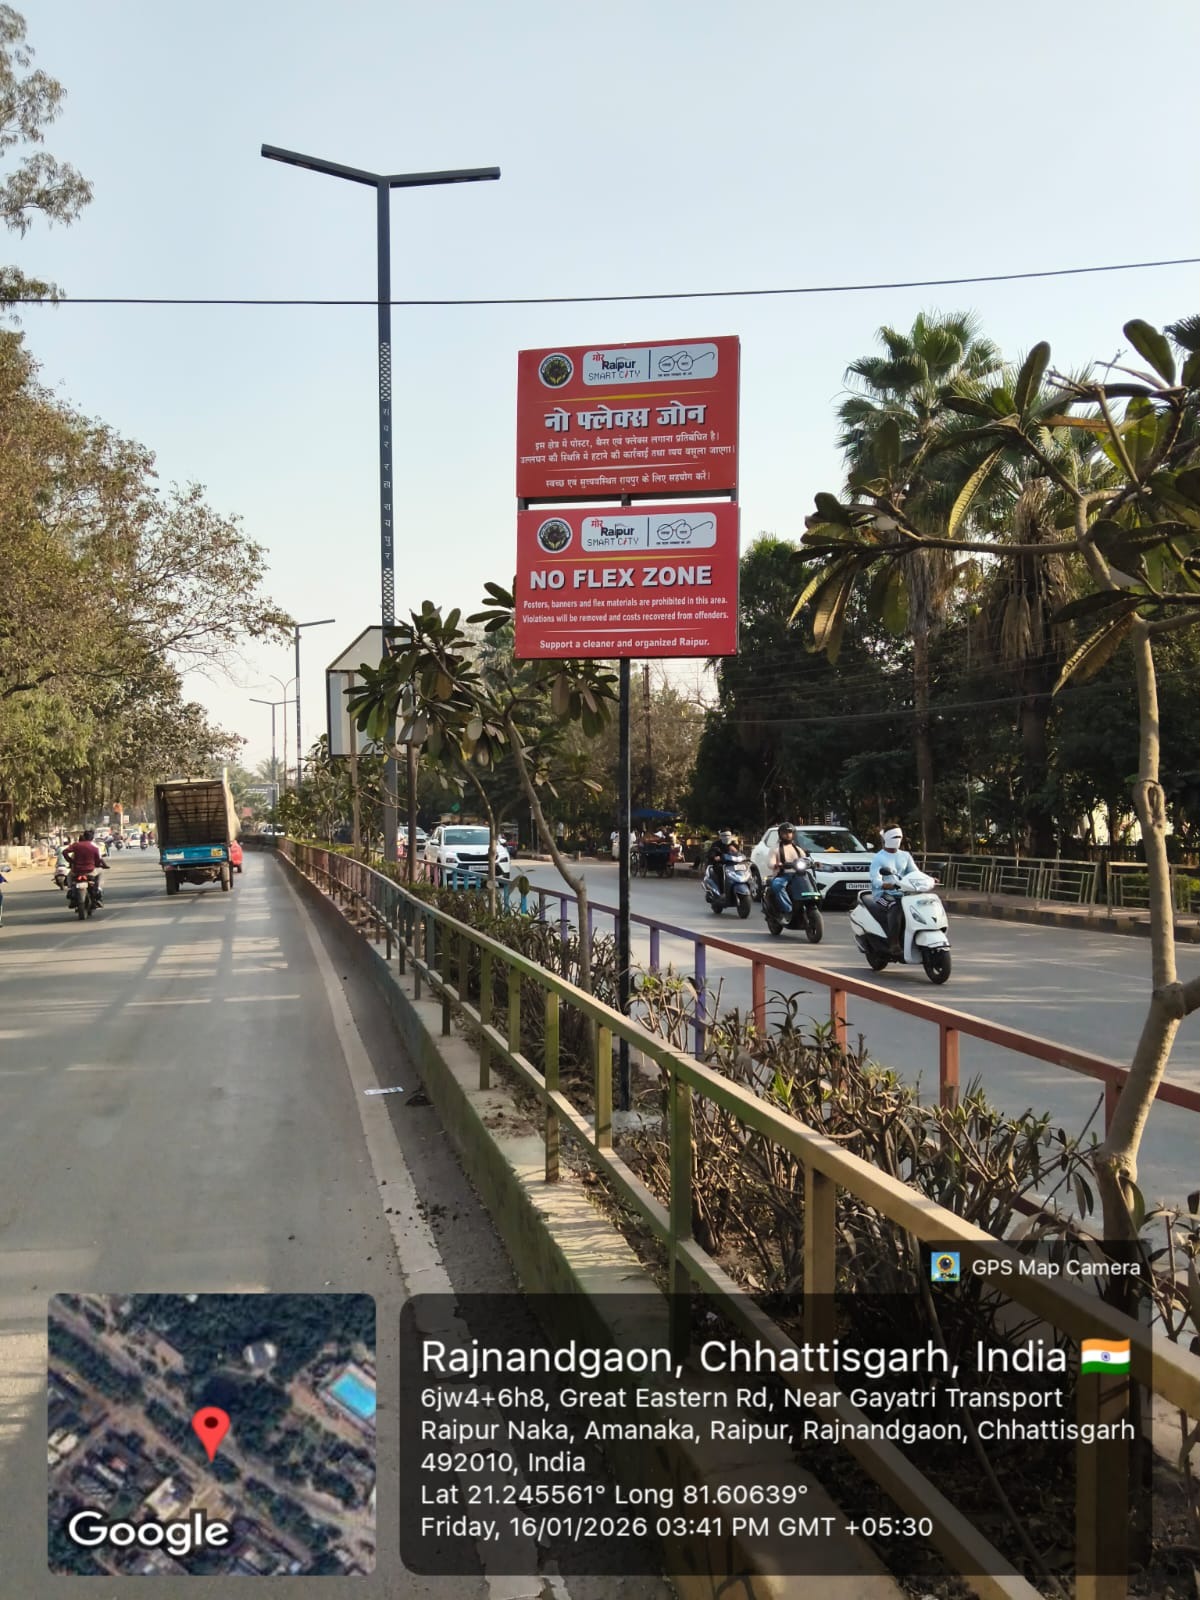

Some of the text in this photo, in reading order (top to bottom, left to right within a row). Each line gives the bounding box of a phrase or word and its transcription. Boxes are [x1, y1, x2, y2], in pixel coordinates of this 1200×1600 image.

[543, 400, 706, 431] नो फ्लेक्स जोन
[530, 565, 711, 589] NO FLEX ZONE
